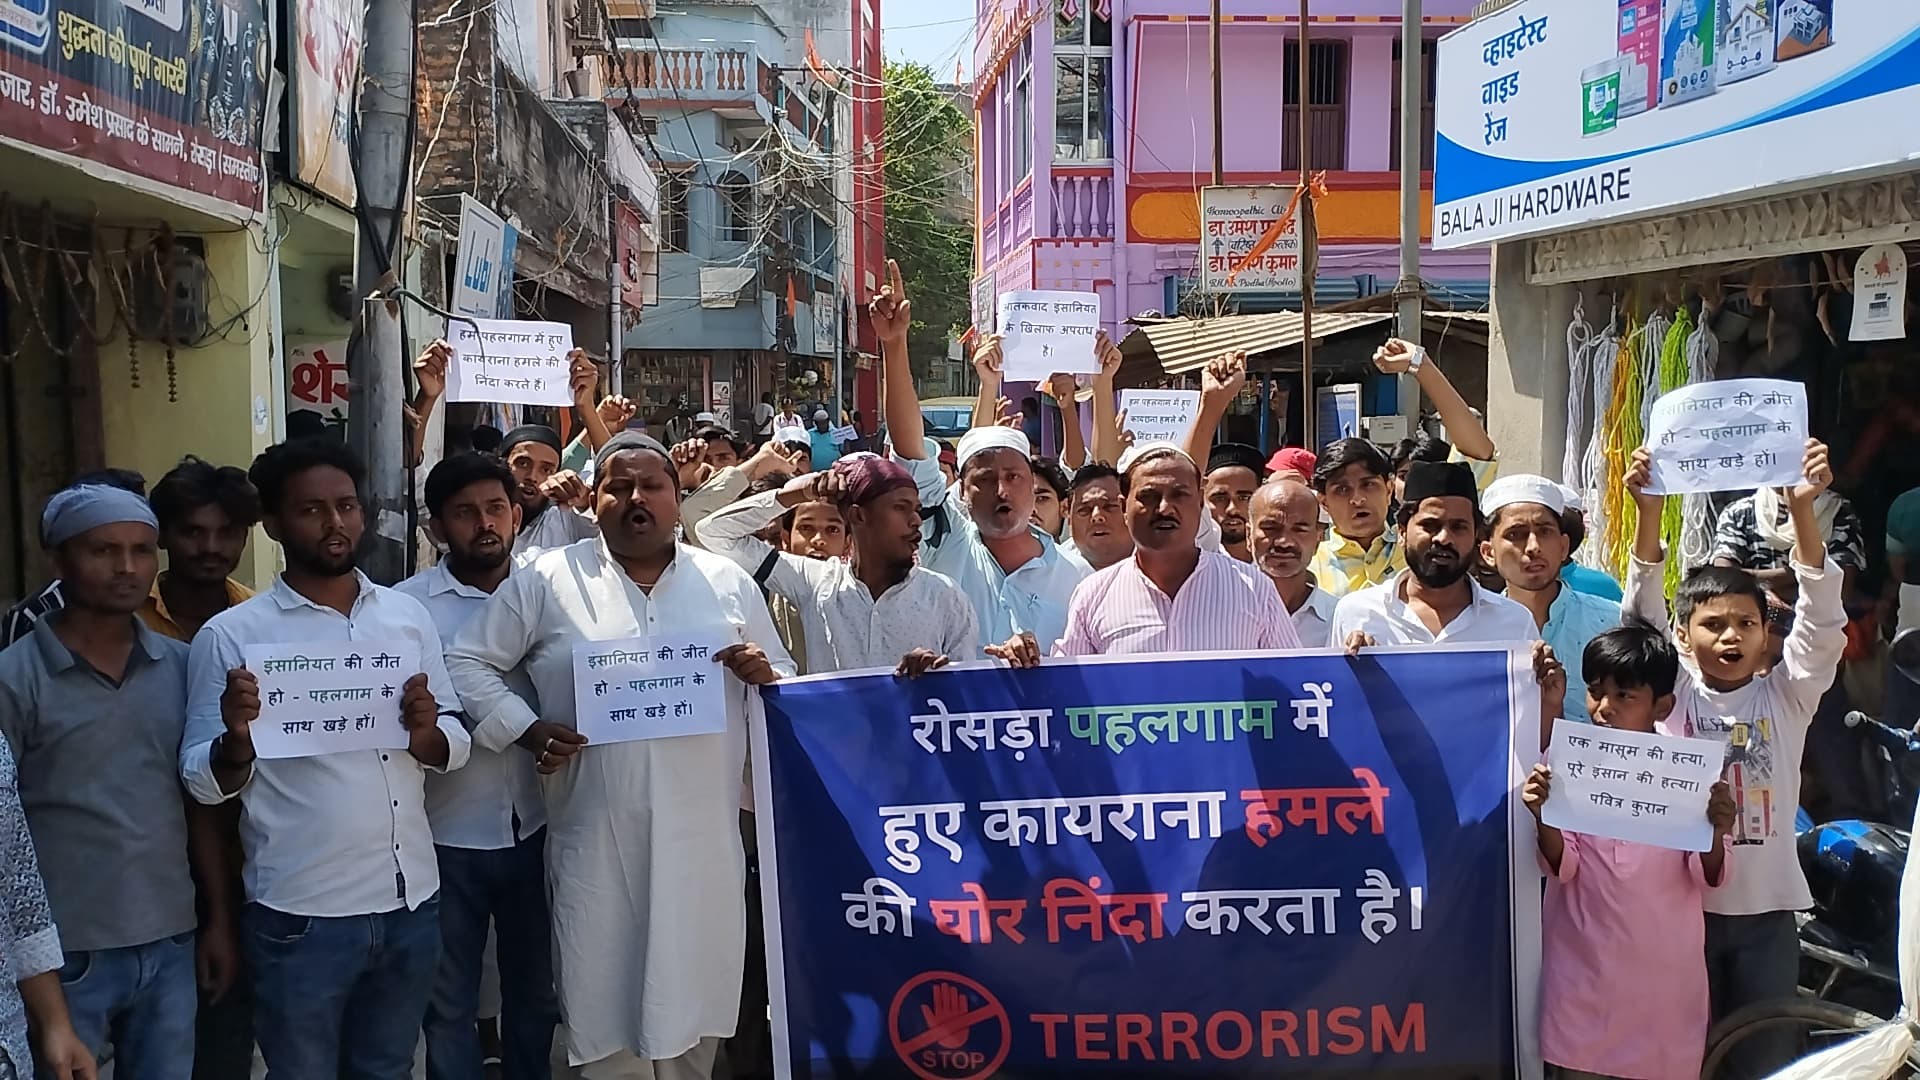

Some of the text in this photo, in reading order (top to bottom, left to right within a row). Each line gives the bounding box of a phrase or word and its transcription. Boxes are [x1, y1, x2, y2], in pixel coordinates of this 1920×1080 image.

[1482, 15, 1548, 66] व्हाइटेस्ट
[108, 26, 127, 68] की
[129, 41, 152, 90] पूर्ण
[1482, 71, 1519, 104] वाइड
[40, 80, 61, 116] डॉ.
[65, 91, 104, 130] उमेश
[104, 109, 135, 142] प्रसाद
[136, 116, 150, 145] के
[151, 129, 188, 162] सामने,
[1441, 167, 1631, 237] BALA JI HARDWARE
[1266, 255, 1297, 276] कुमार
[1053, 300, 1097, 314] इंसानियत
[460, 329, 563, 351] हम पहलगाम में हुए
[1060, 325, 1094, 335] अपराध
[463, 354, 559, 368] कायराना हमले की
[504, 378, 530, 390] करते
[1733, 392, 1753, 406] की
[1762, 390, 1793, 406] जीत
[1660, 429, 1676, 445] हो
[1700, 422, 1768, 441] पहलगाम
[1776, 418, 1792, 433] के
[1677, 457, 1709, 472] साथ
[1754, 449, 1777, 468] हों।
[263, 653, 401, 675] इंसानियत की जीत
[588, 644, 709, 669] इंसानियत की जीत
[268, 688, 285, 706] हो
[309, 688, 373, 704] पहलगाम
[381, 684, 396, 699] के
[594, 680, 608, 696] हो
[628, 676, 685, 692] पहलगाम
[692, 672, 706, 687] के
[282, 713, 376, 735] साथ खड़े हों।
[610, 700, 693, 723] साथ खड़े हों।
[910, 682, 1333, 762] रोसड़ा पहलगाम में
[1568, 735, 1707, 768] एक मासूम की हत्या,
[1567, 761, 1700, 793] पूरे इंसान की हत्या।
[1590, 792, 1669, 817] पवित्र कुरान
[879, 767, 1390, 873] हुए कायराना हमले
[841, 877, 917, 937] की
[929, 881, 1027, 944] घोर
[1041, 876, 1169, 944] निंदा
[1181, 888, 1340, 936] करता
[922, 1002, 1426, 1070] STOP TERRORISM
